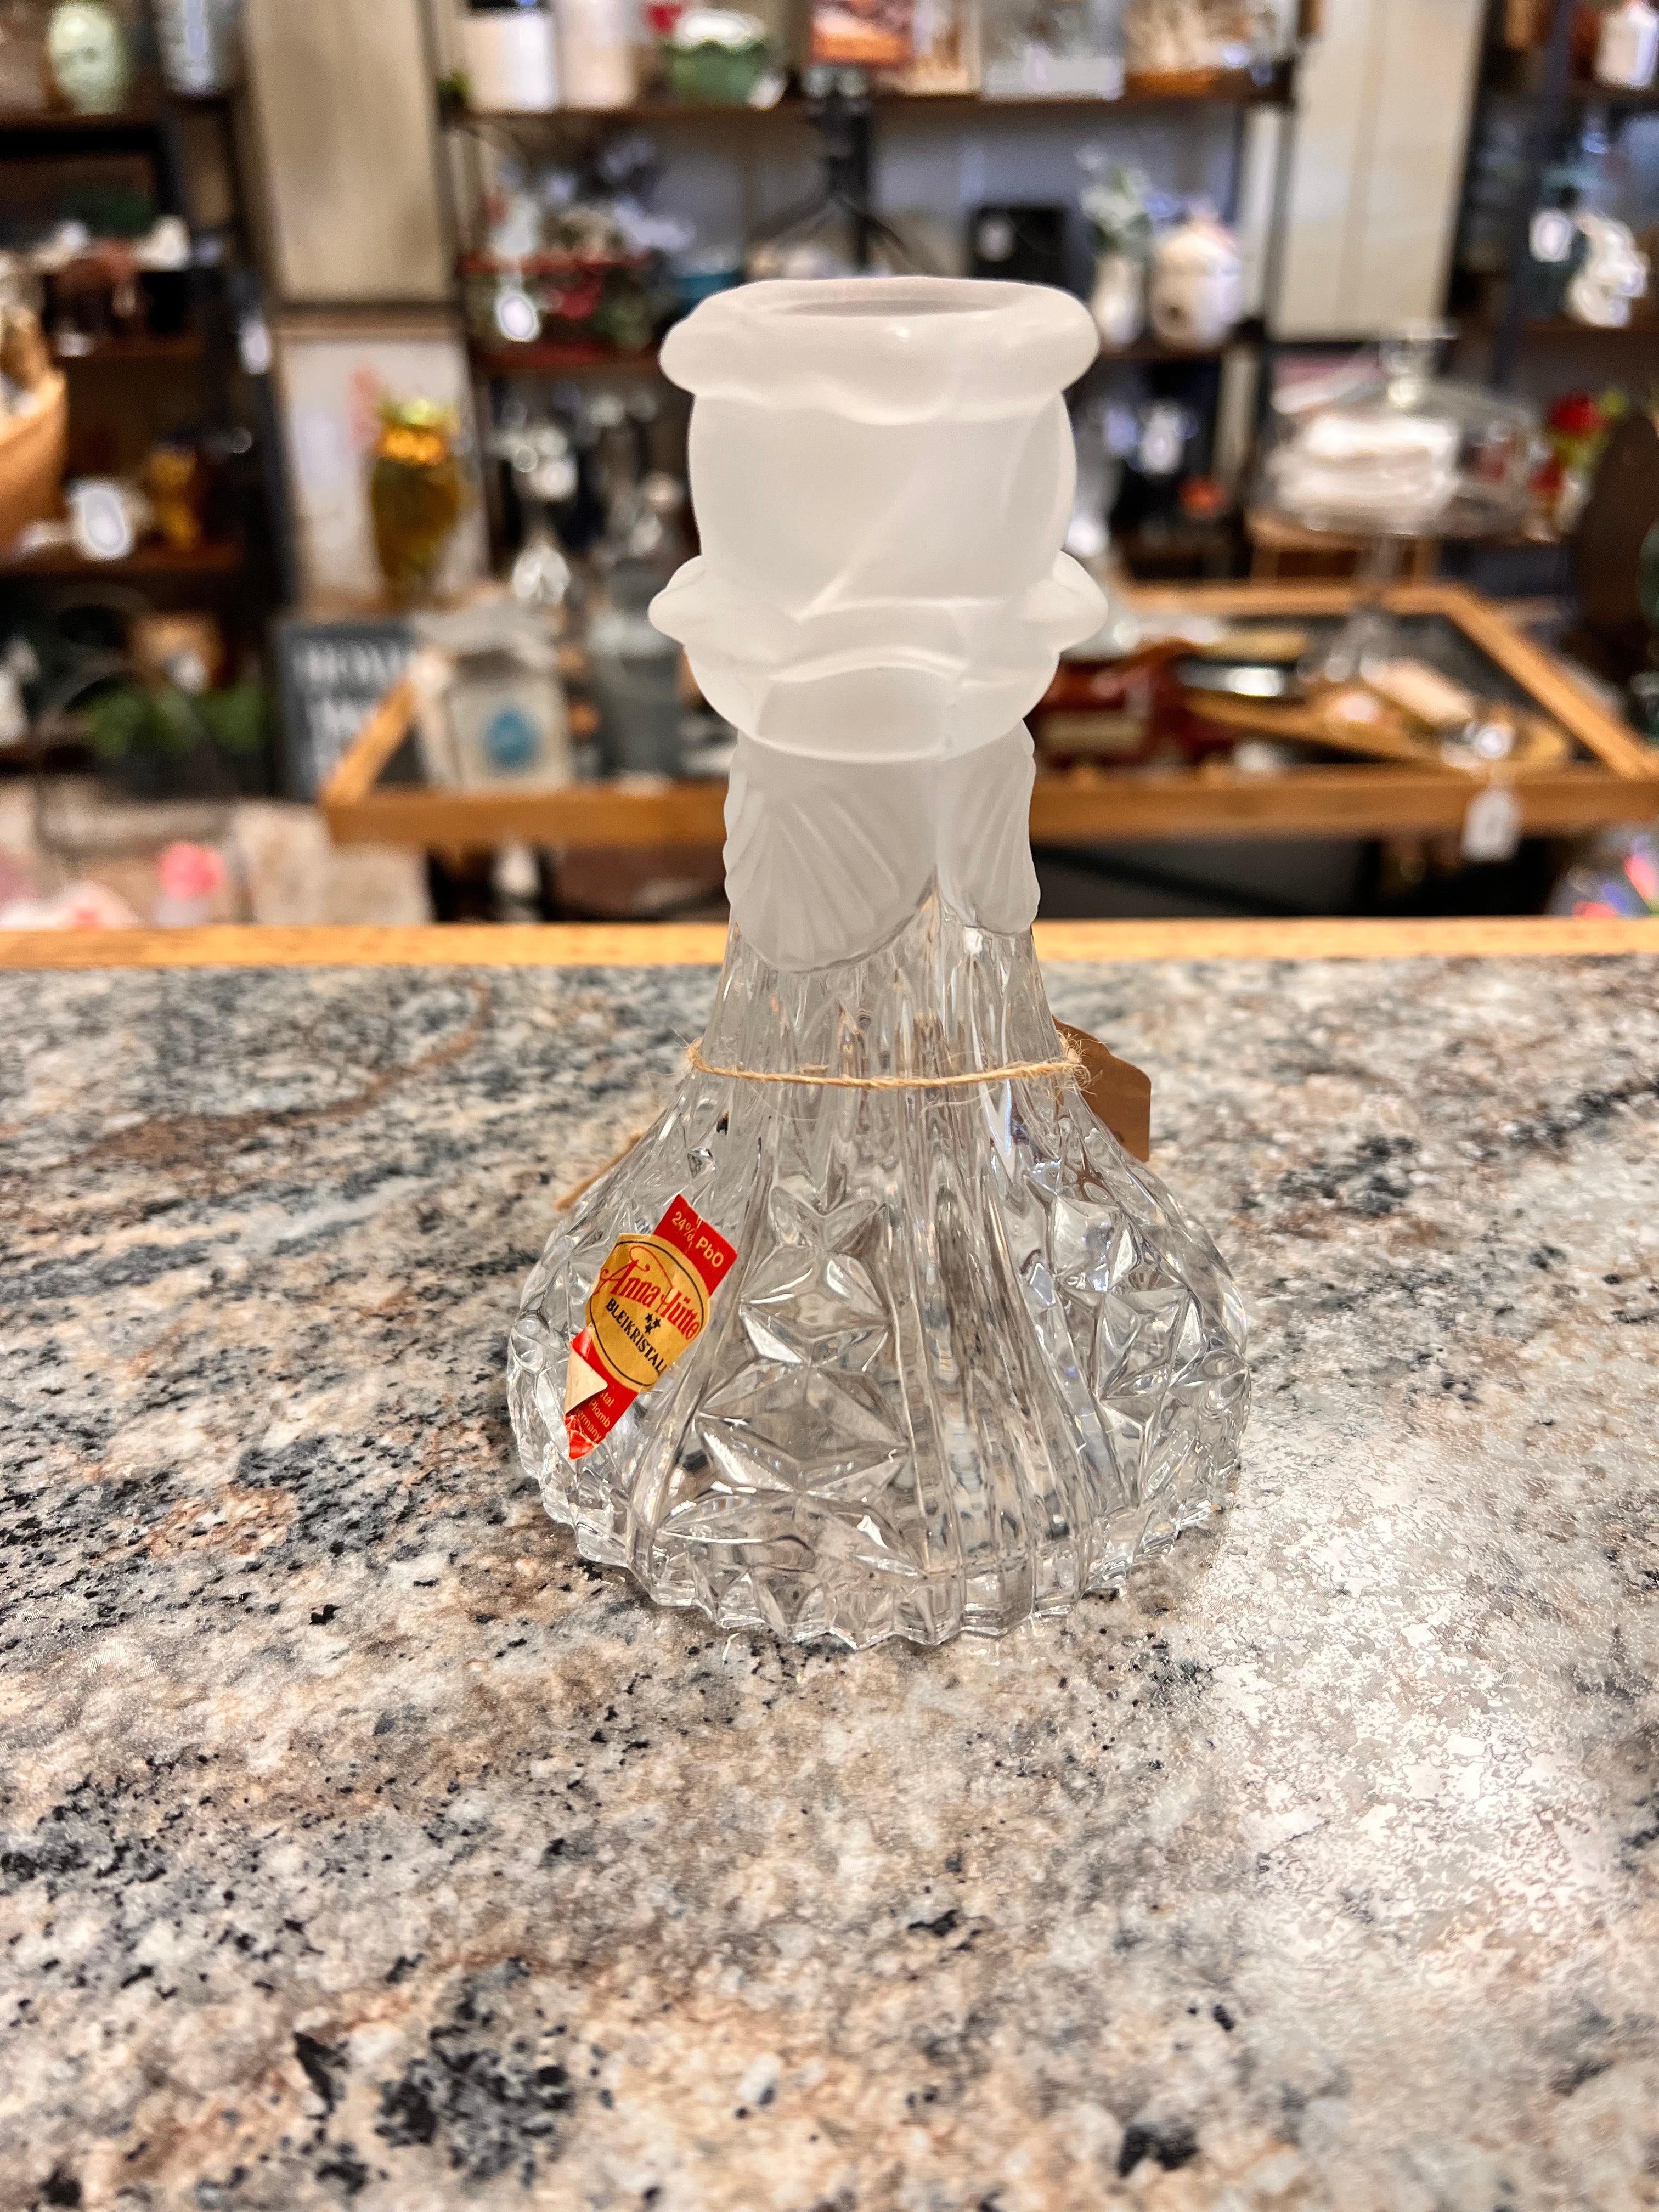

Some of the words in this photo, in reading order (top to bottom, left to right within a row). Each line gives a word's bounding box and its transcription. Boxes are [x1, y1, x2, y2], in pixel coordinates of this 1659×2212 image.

[672, 1211, 695, 1242] 24%
[696, 1235, 724, 1268] PbO
[592, 1259, 661, 1308] Anna
[589, 1398, 611, 1427] Plomb
